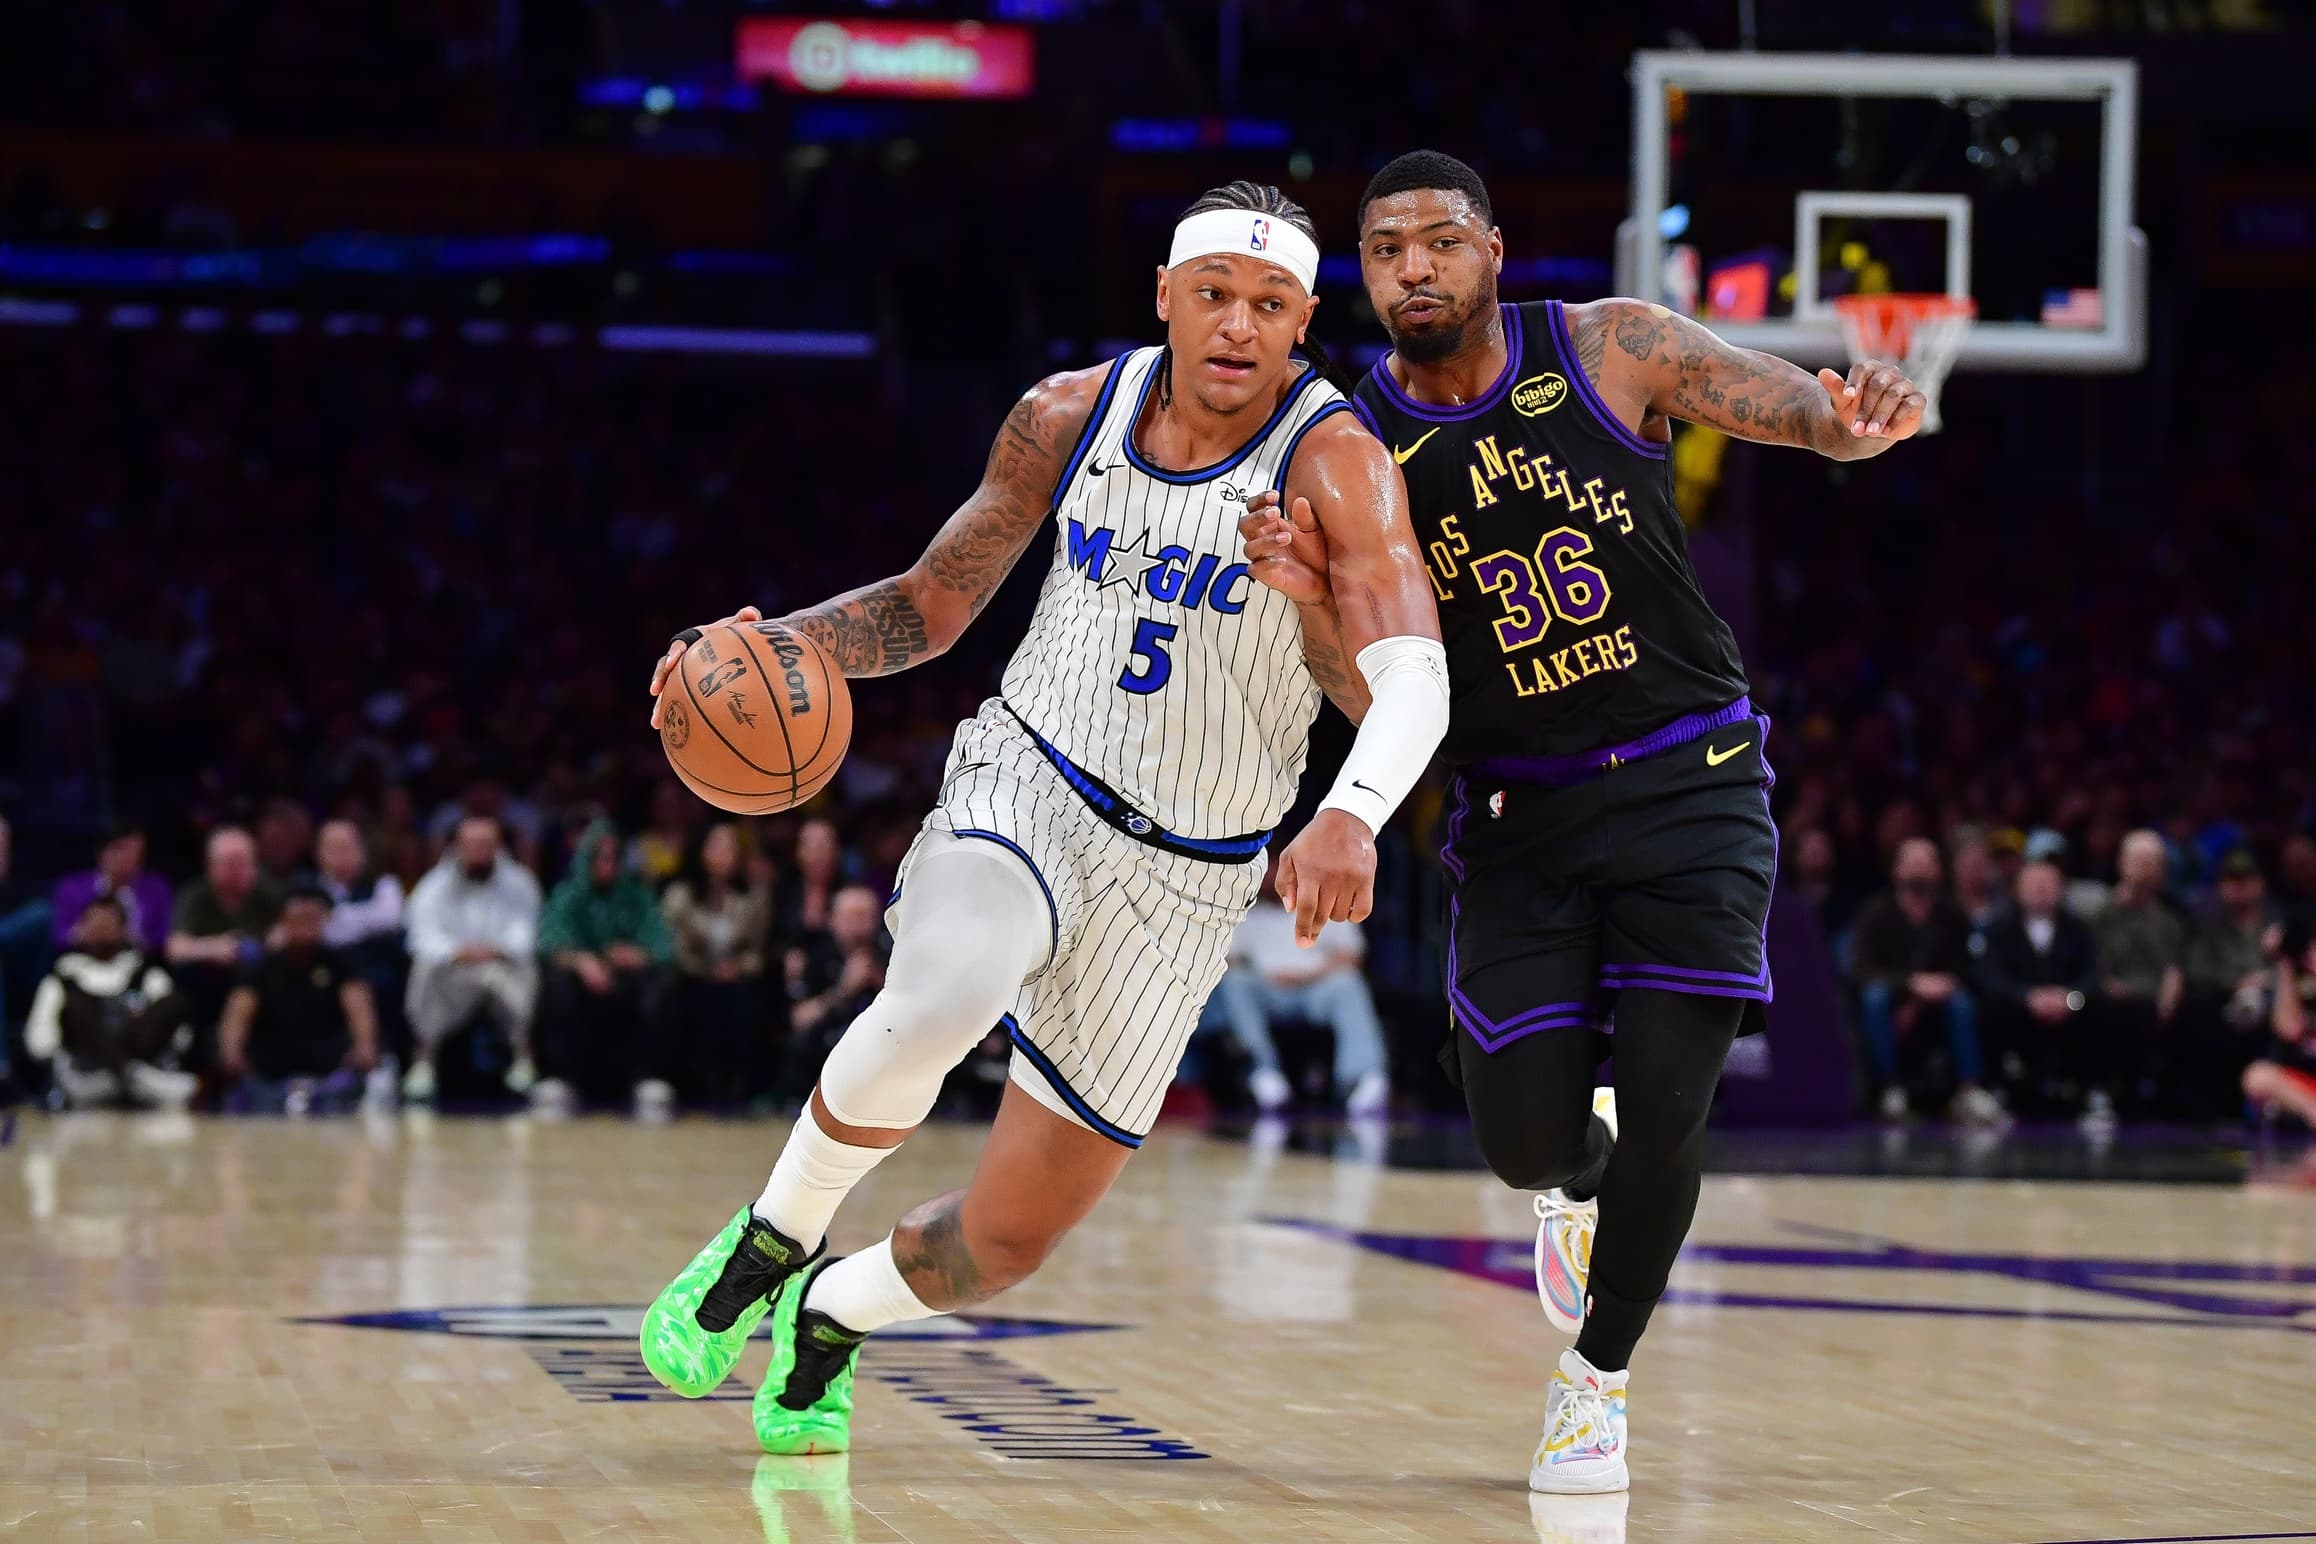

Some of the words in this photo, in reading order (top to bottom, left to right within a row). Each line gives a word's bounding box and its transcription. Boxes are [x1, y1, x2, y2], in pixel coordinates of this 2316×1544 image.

[1515, 381, 1563, 406] bibigo
[1219, 480, 1249, 504] Dis
[1425, 514, 1470, 601] LOS
[1467, 434, 1634, 536] ANGELES
[1469, 525, 1612, 654] 36
[1116, 616, 1179, 696] 5
[1505, 624, 1638, 697] LAKERS
